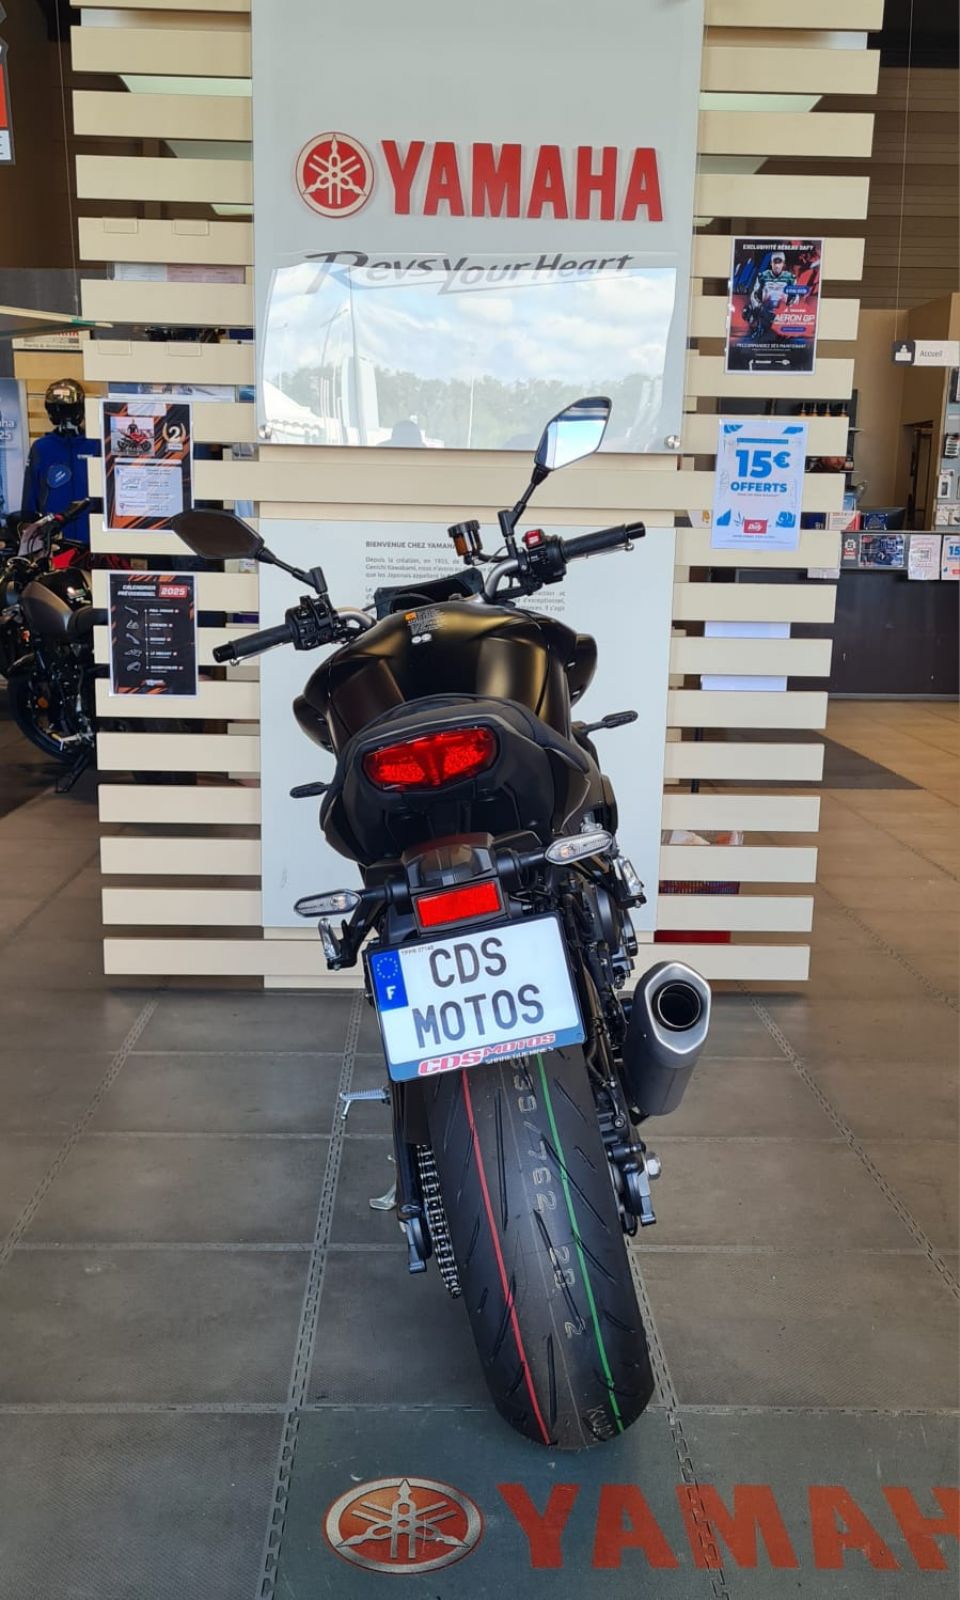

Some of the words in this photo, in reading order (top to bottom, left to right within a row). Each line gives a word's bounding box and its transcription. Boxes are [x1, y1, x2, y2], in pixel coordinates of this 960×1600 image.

[380, 140, 664, 222] YAMAHA
[304, 250, 438, 295] Revs
[438, 256, 532, 295] Your
[528, 253, 635, 279] Heart
[774, 314, 802, 322] AERON
[802, 314, 816, 322] GP
[919, 350, 943, 358] Accueil
[168, 426, 180, 440] 2
[736, 450, 791, 478] 15€
[730, 481, 788, 493] OFFERTS
[365, 541, 406, 549] BIENVENUE
[365, 557, 386, 565] Depuis
[160, 587, 186, 596] 2025
[429, 937, 507, 988] CDS
[386, 985, 396, 1000] F
[411, 984, 545, 1049] MOTOS
[418, 1050, 482, 1076] CDS
[483, 1033, 556, 1057] MOTOS
